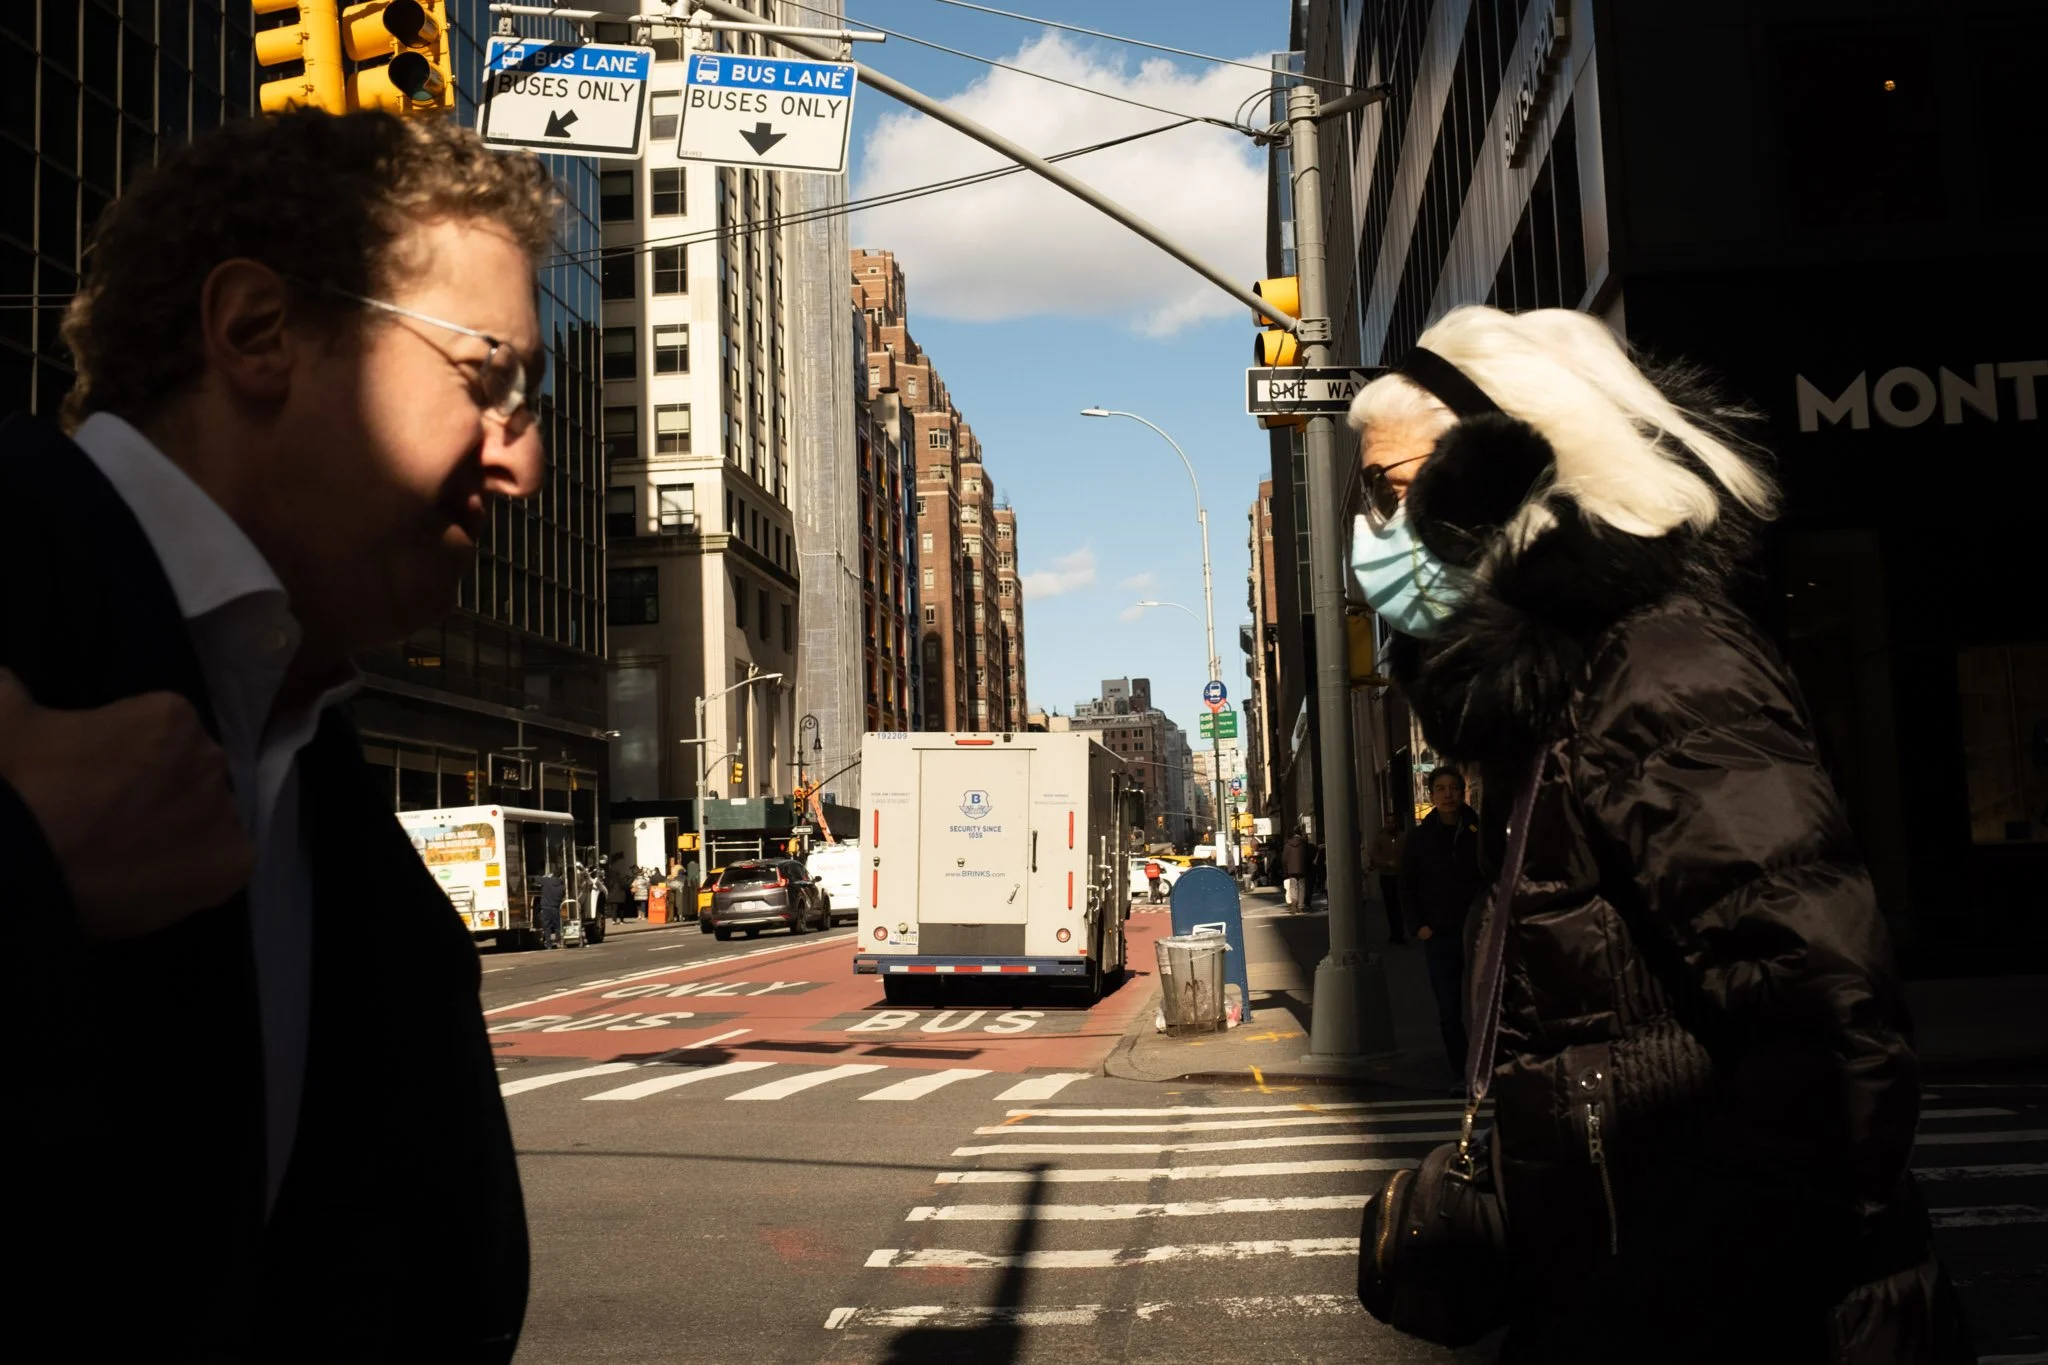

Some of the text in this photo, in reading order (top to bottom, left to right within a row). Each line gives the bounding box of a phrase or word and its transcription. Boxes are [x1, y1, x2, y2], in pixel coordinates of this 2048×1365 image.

[534, 51, 638, 73] BUS LANE
[498, 74, 635, 102] BUSES ONLY
[731, 64, 845, 89] BUS LANE
[691, 88, 842, 118] BUSES ONLY
[1270, 382, 1308, 399] ONE
[1796, 360, 2048, 432] MONT
[971, 793, 981, 804] B
[949, 825, 1002, 833] SECURITY SINCE
[601, 981, 809, 998] ONLY
[487, 1011, 694, 1034] BUS
[857, 1010, 1045, 1034] BUS
